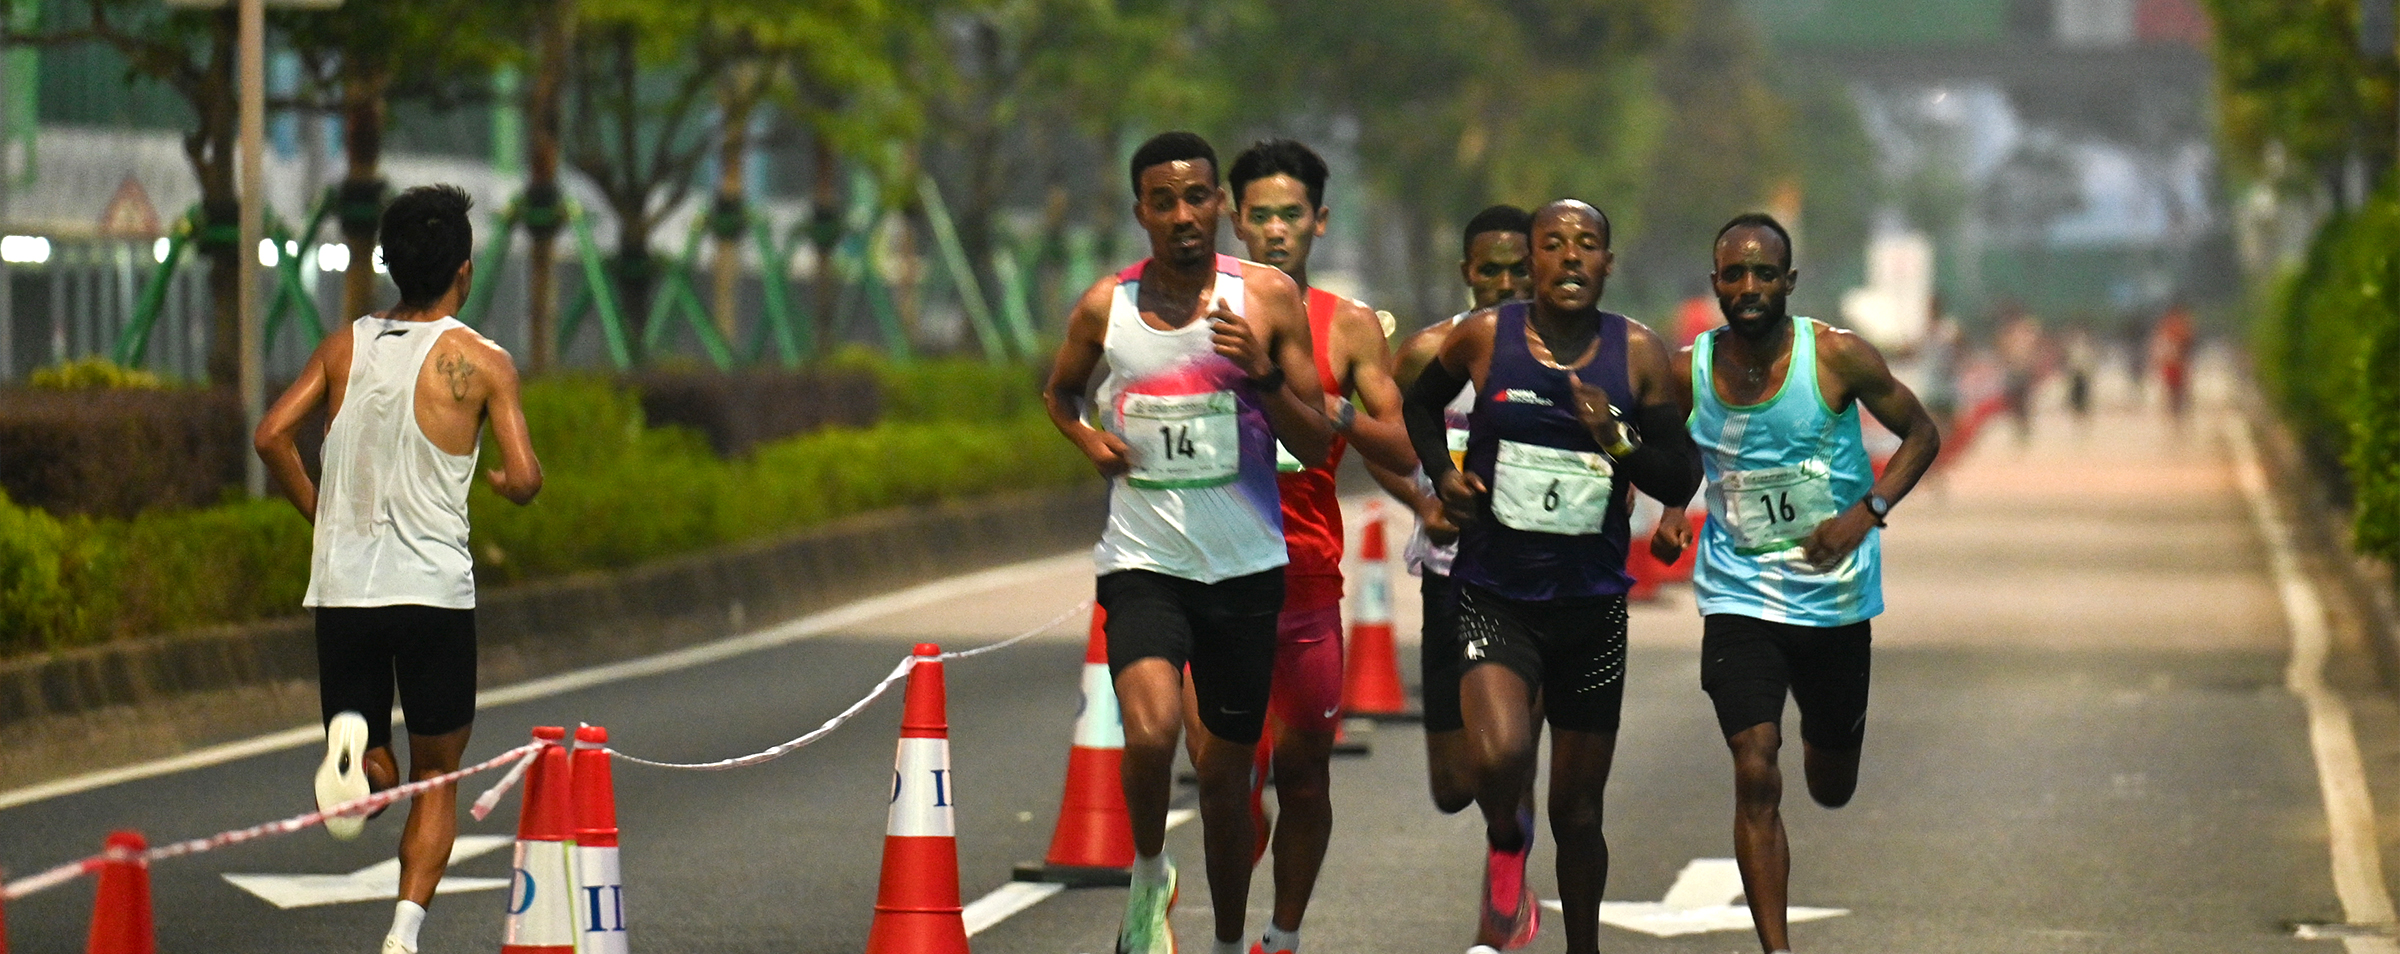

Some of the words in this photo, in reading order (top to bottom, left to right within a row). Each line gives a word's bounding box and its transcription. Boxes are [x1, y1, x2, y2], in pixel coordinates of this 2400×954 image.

[1160, 425, 1195, 461] 14
[1543, 477, 1560, 512] 6
[1760, 491, 1796, 525] 16
